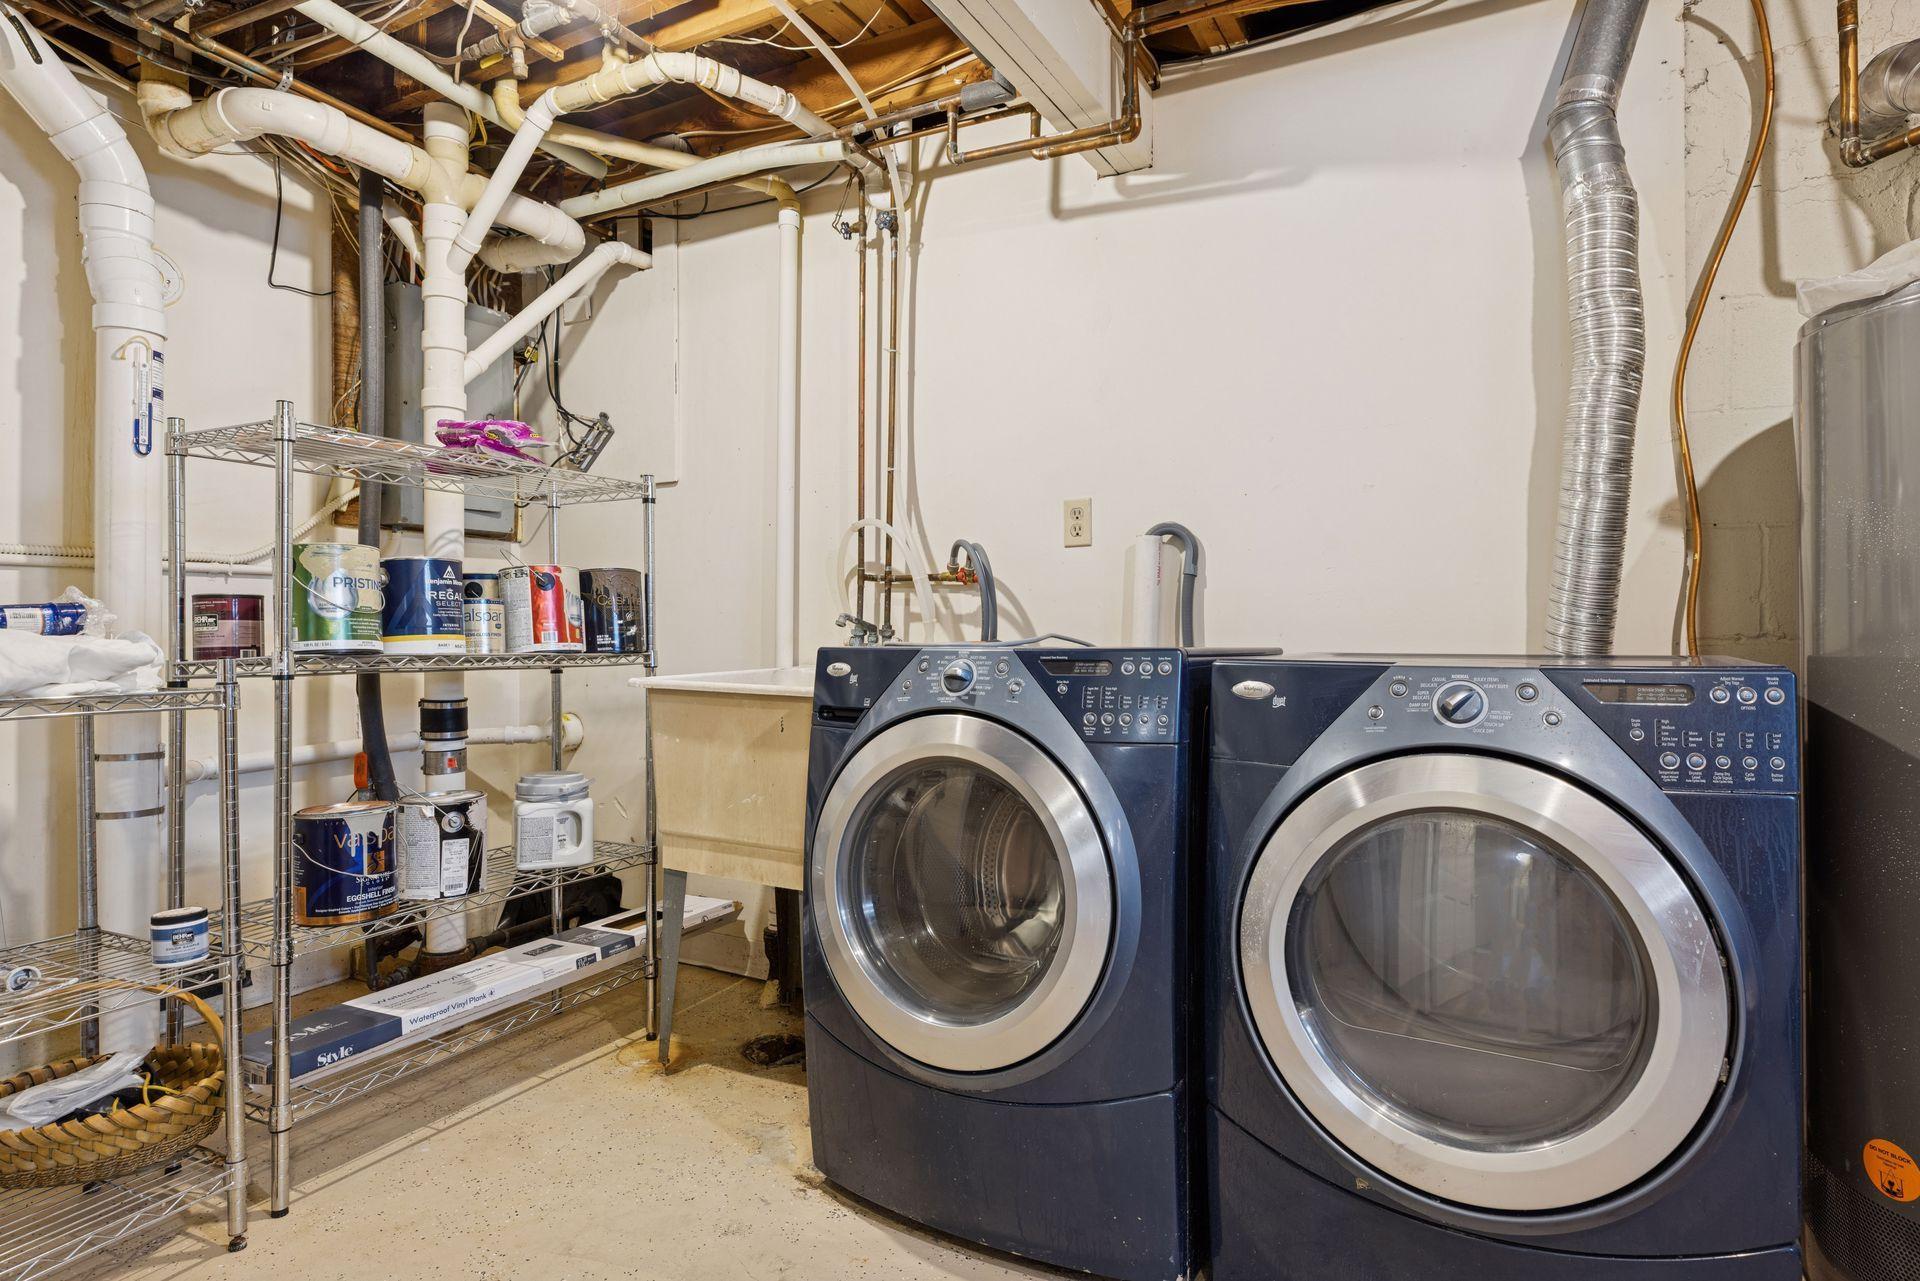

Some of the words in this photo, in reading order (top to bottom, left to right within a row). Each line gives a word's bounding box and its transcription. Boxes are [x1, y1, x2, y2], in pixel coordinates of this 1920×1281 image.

[428, 590, 463, 601] REGAL
[464, 608, 501, 624] alspar
[346, 888, 381, 903] EGGSHELL
[382, 885, 396, 896] FINISH
[408, 1004, 451, 1026] Waterproof
[451, 998, 469, 1012] Vinyl
[468, 991, 487, 1004] Plank
[317, 1045, 353, 1067] Style
[1877, 1147, 1890, 1156] NOT
[1890, 1153, 1912, 1165] BLOCK
